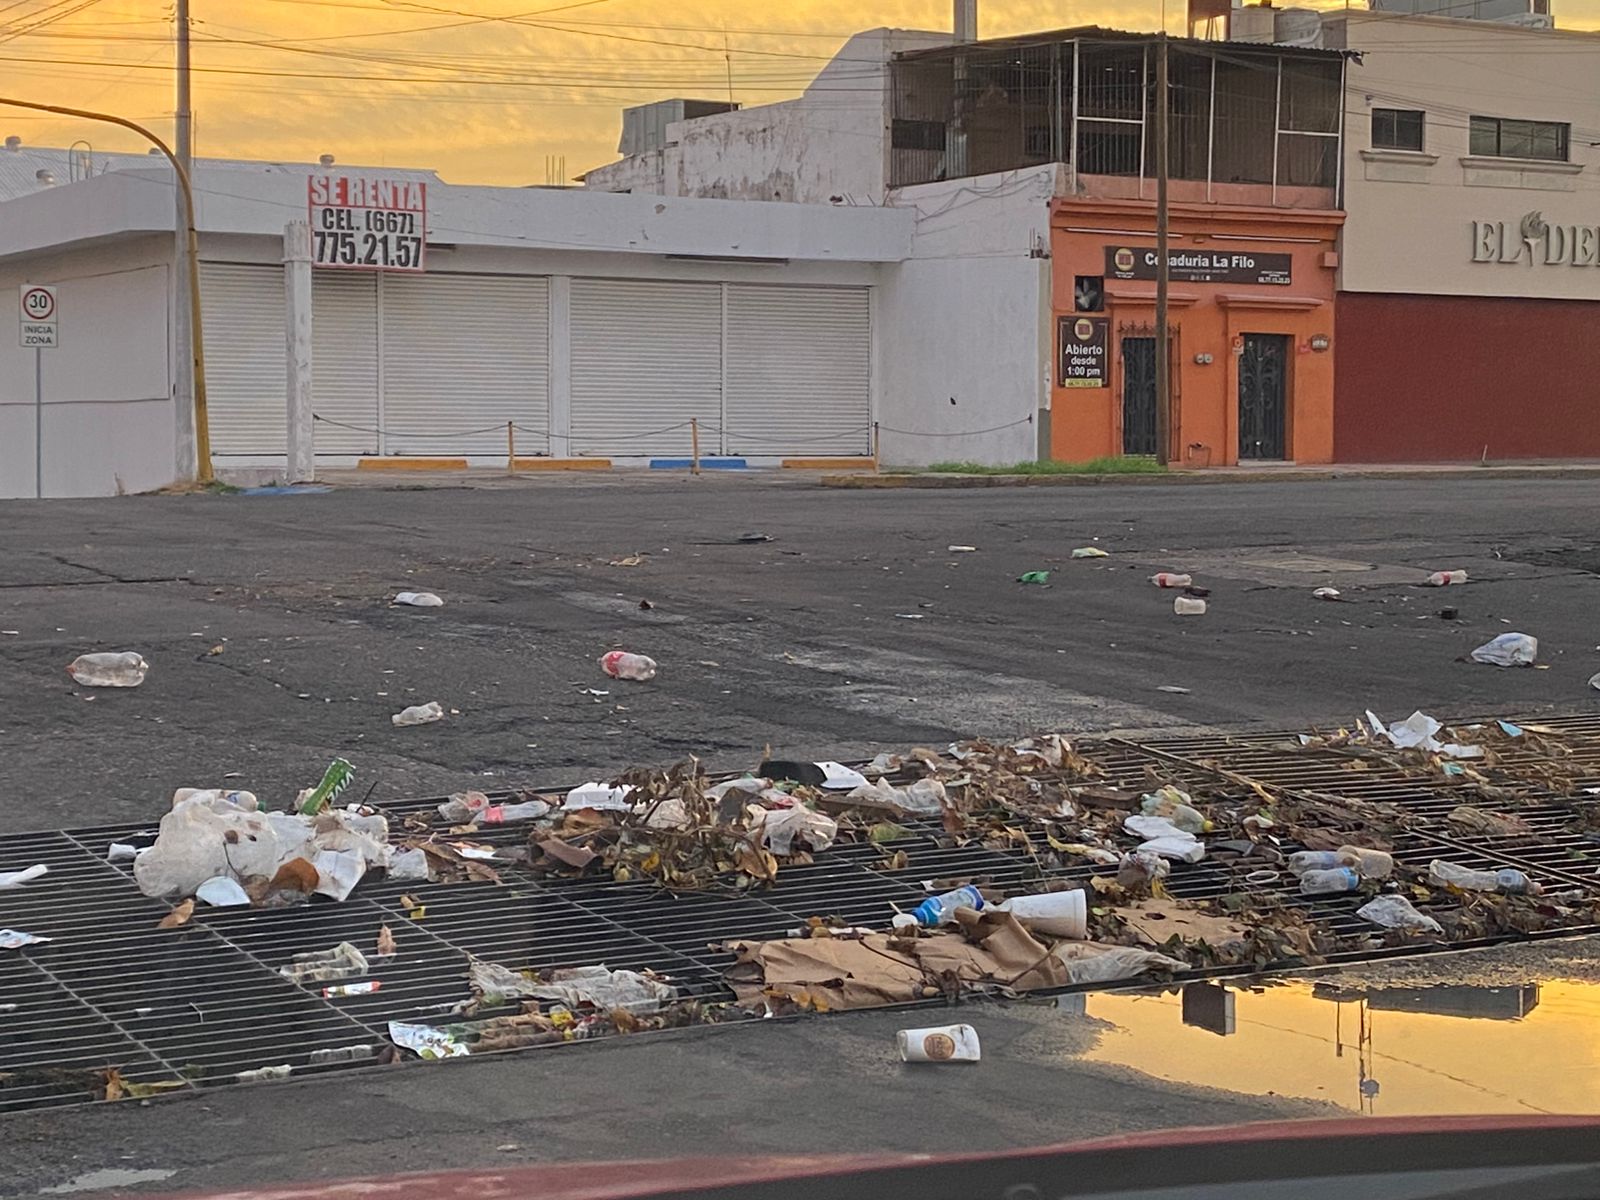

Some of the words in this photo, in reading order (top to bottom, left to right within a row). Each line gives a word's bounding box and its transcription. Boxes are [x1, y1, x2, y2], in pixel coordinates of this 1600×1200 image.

[311, 176, 340, 206] SE
[349, 178, 422, 210] RENTA
[322, 208, 360, 230] CEL.
[314, 231, 422, 267] 775.21.57
[1471, 220, 1521, 263] EL
[1543, 223, 1600, 267] DE
[1145, 252, 1209, 267] Caduria
[1213, 255, 1228, 267] La
[1232, 256, 1255, 268] Filo
[29, 294, 47, 309] 30
[24, 326, 53, 334] INICIA
[25, 336, 52, 345] ZONA
[1065, 344, 1103, 355] Abierto
[1071, 356, 1097, 365] desde
[1067, 367, 1085, 376] 1:00
[1087, 368, 1100, 377] pm
